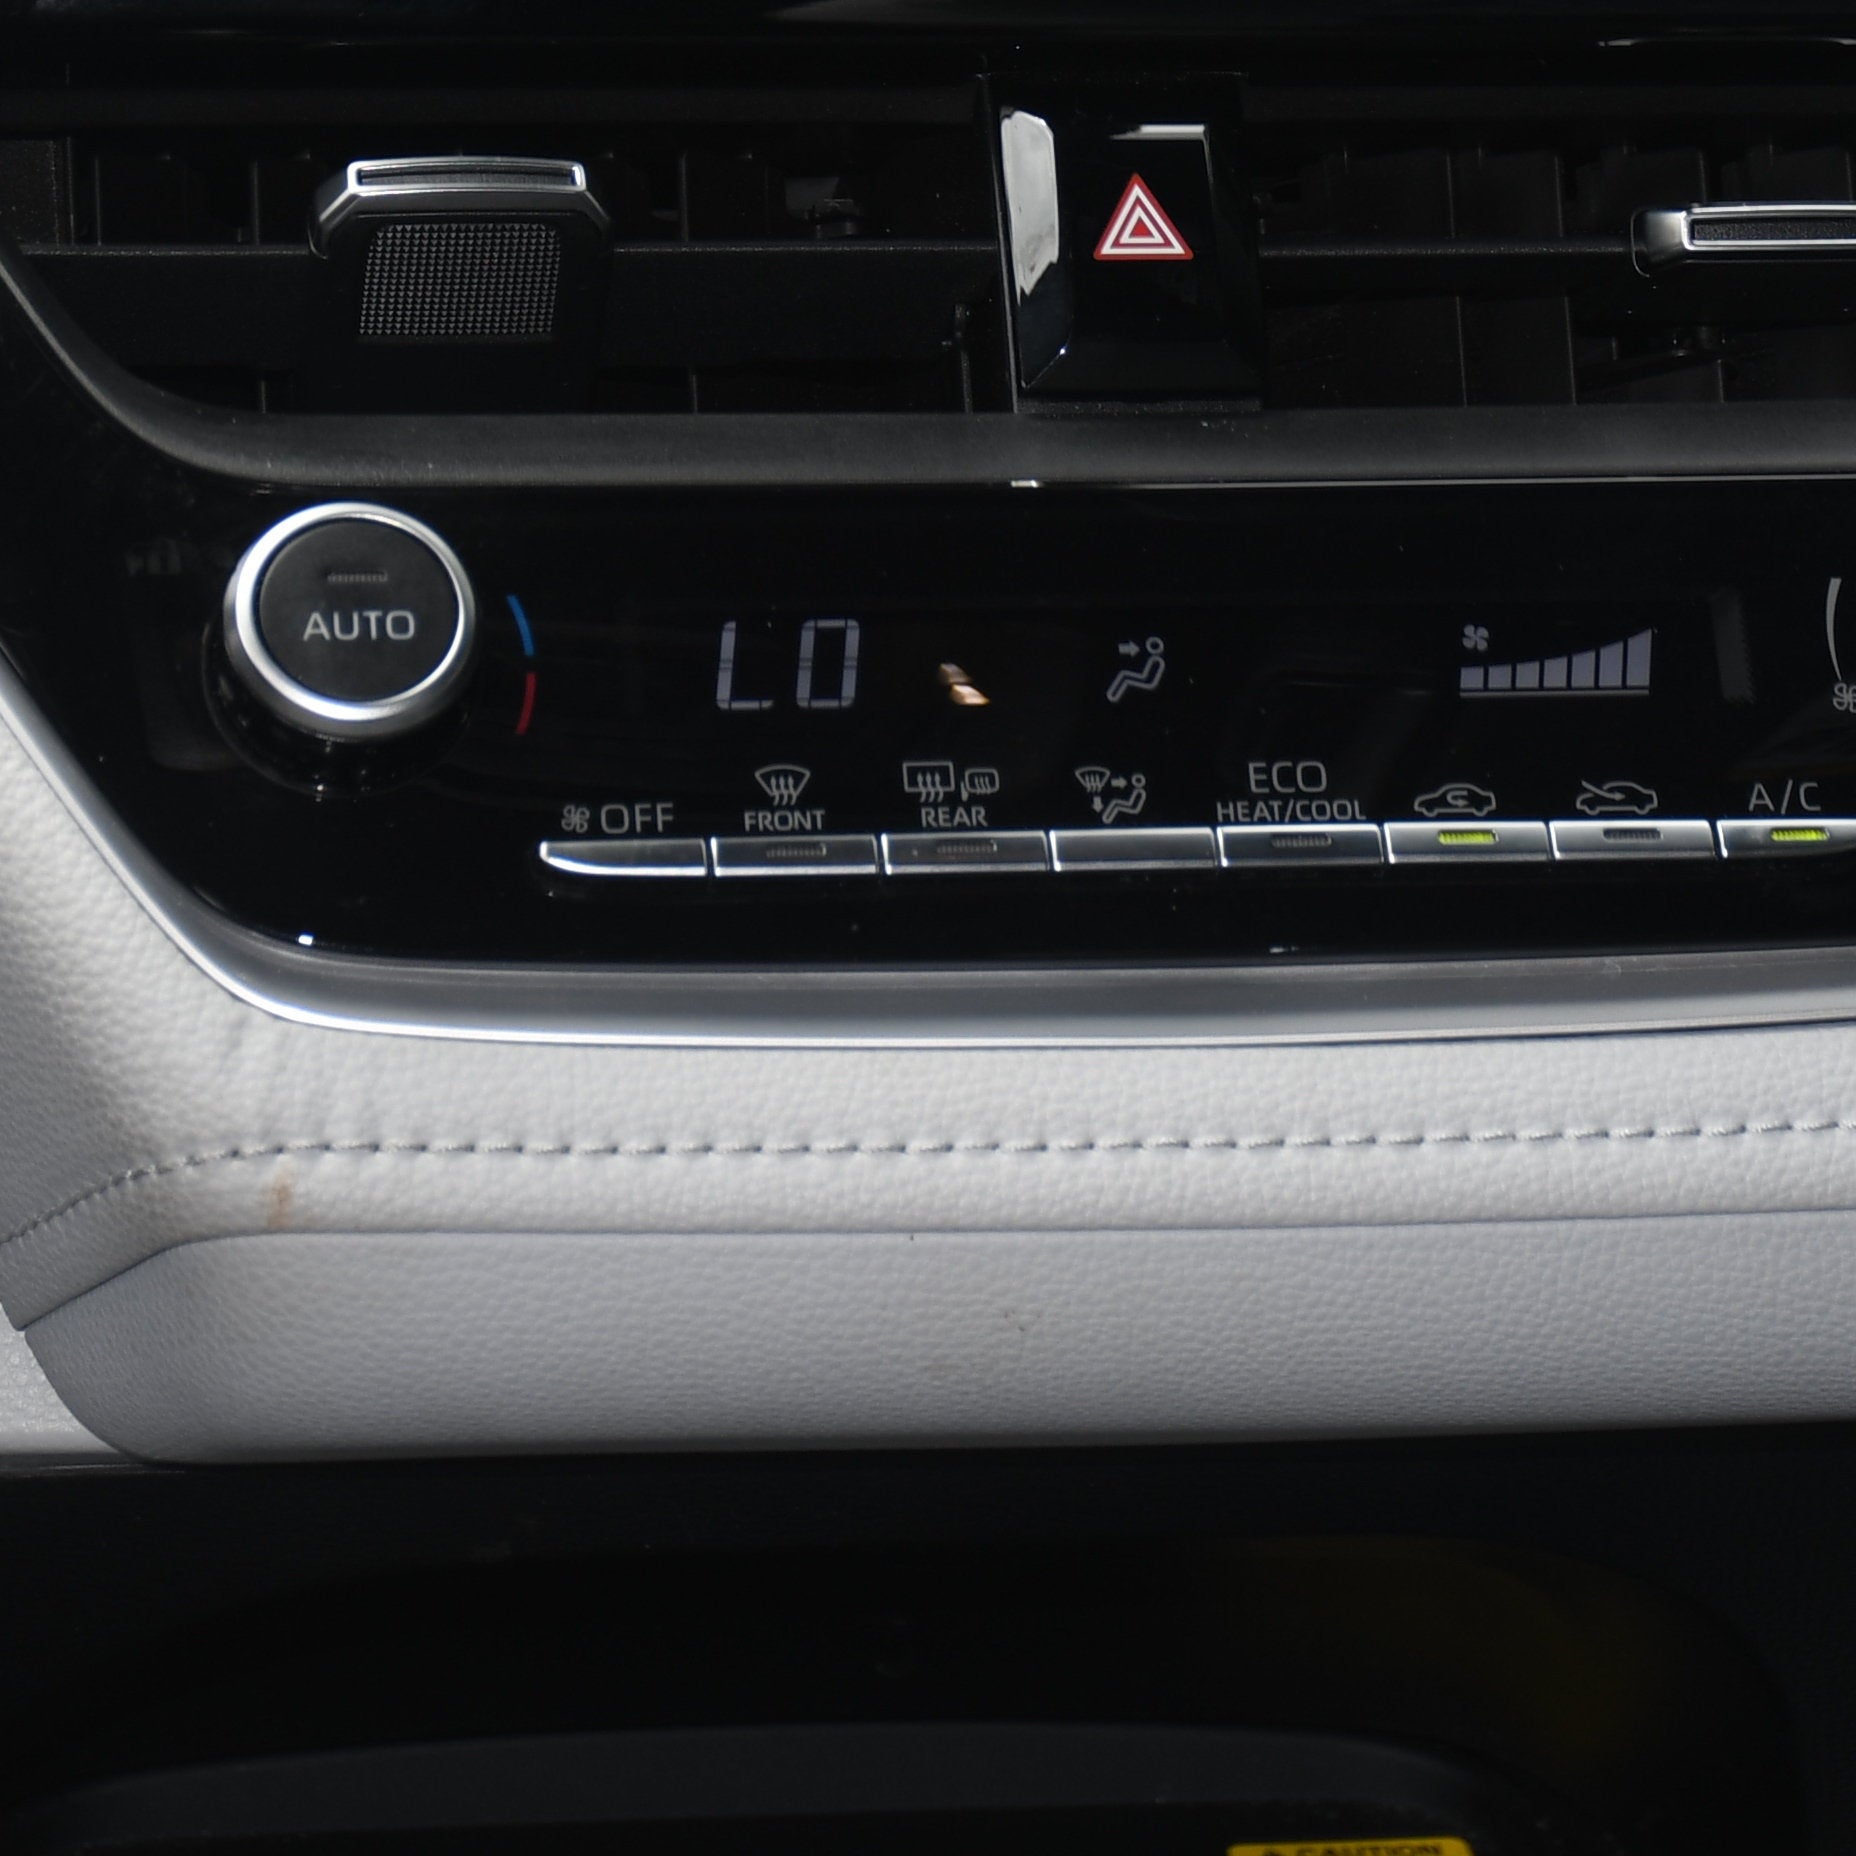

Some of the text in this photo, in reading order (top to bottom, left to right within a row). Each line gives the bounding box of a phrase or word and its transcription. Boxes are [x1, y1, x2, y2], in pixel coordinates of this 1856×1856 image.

[303, 610, 415, 641] AUTO
[715, 618, 861, 711] LO
[1246, 760, 1328, 796] ECO
[1215, 796, 1368, 825] HEAT/COOL
[1748, 778, 1823, 815] A/C
[599, 800, 676, 836] OFF
[743, 807, 826, 834] FRONT
[919, 804, 989, 830] REAR
